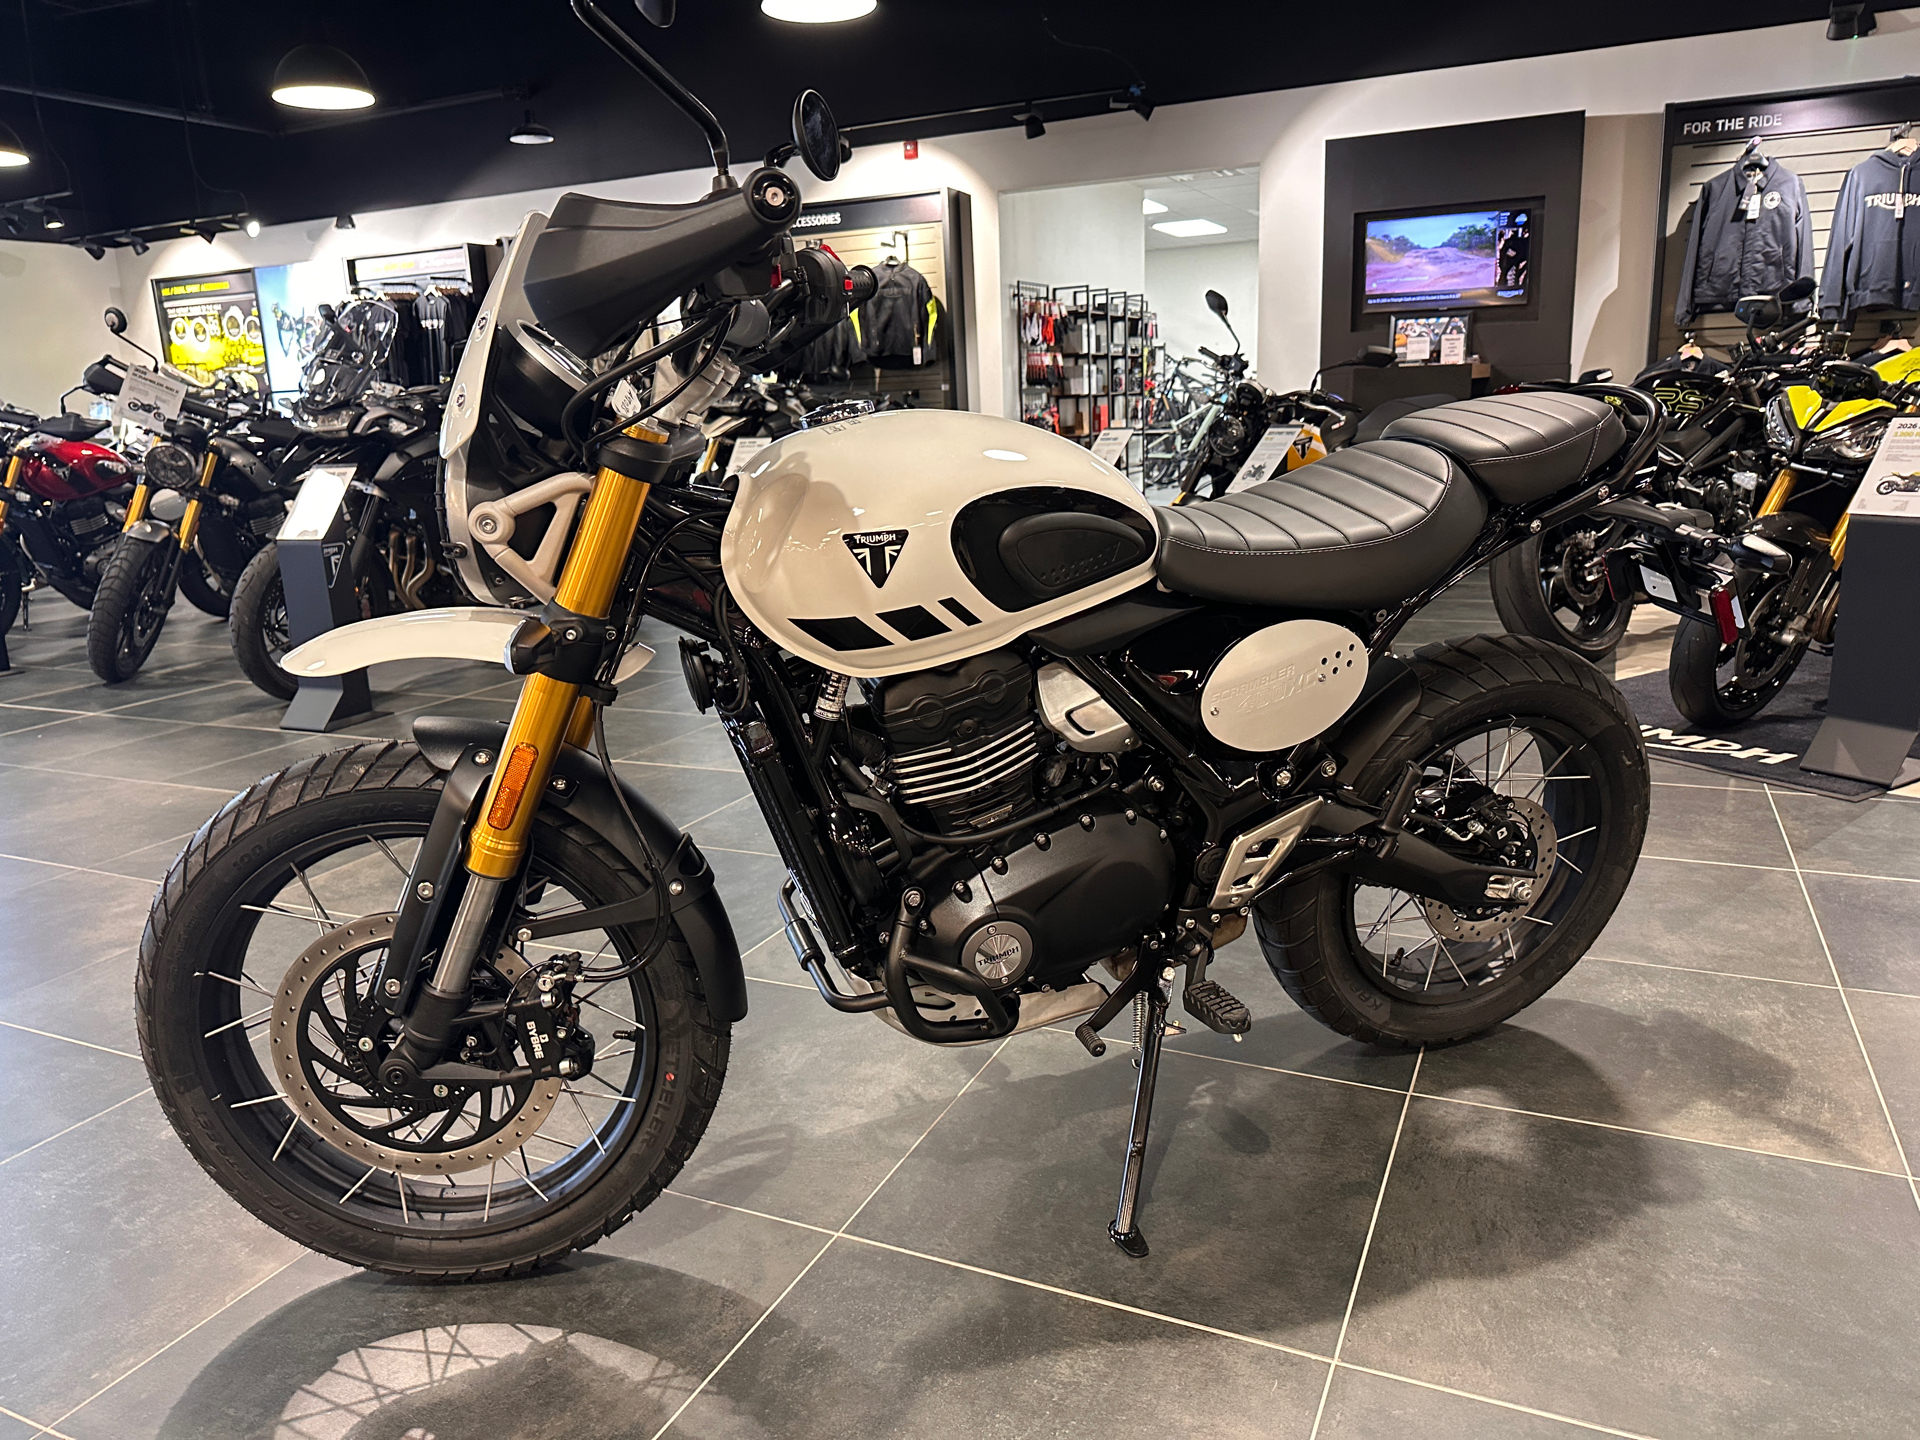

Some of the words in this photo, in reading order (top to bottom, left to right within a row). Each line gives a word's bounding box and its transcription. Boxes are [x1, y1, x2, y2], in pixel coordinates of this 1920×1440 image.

[1683, 121, 1711, 135] FOR
[1716, 117, 1744, 132] THE
[1748, 113, 1783, 129] RIDE
[1864, 193, 1920, 209] TRIUPH
[792, 212, 841, 227] CESSORIES
[1653, 387, 1708, 414] RS
[853, 532, 896, 546] TRIUMPH
[1210, 664, 1296, 706] SCRAMBLER
[1237, 668, 1318, 714] 400XC
[977, 946, 1020, 966] TRIUMPH
[526, 1021, 544, 1060] BYBRE
[638, 1014, 682, 1149] METZELER
